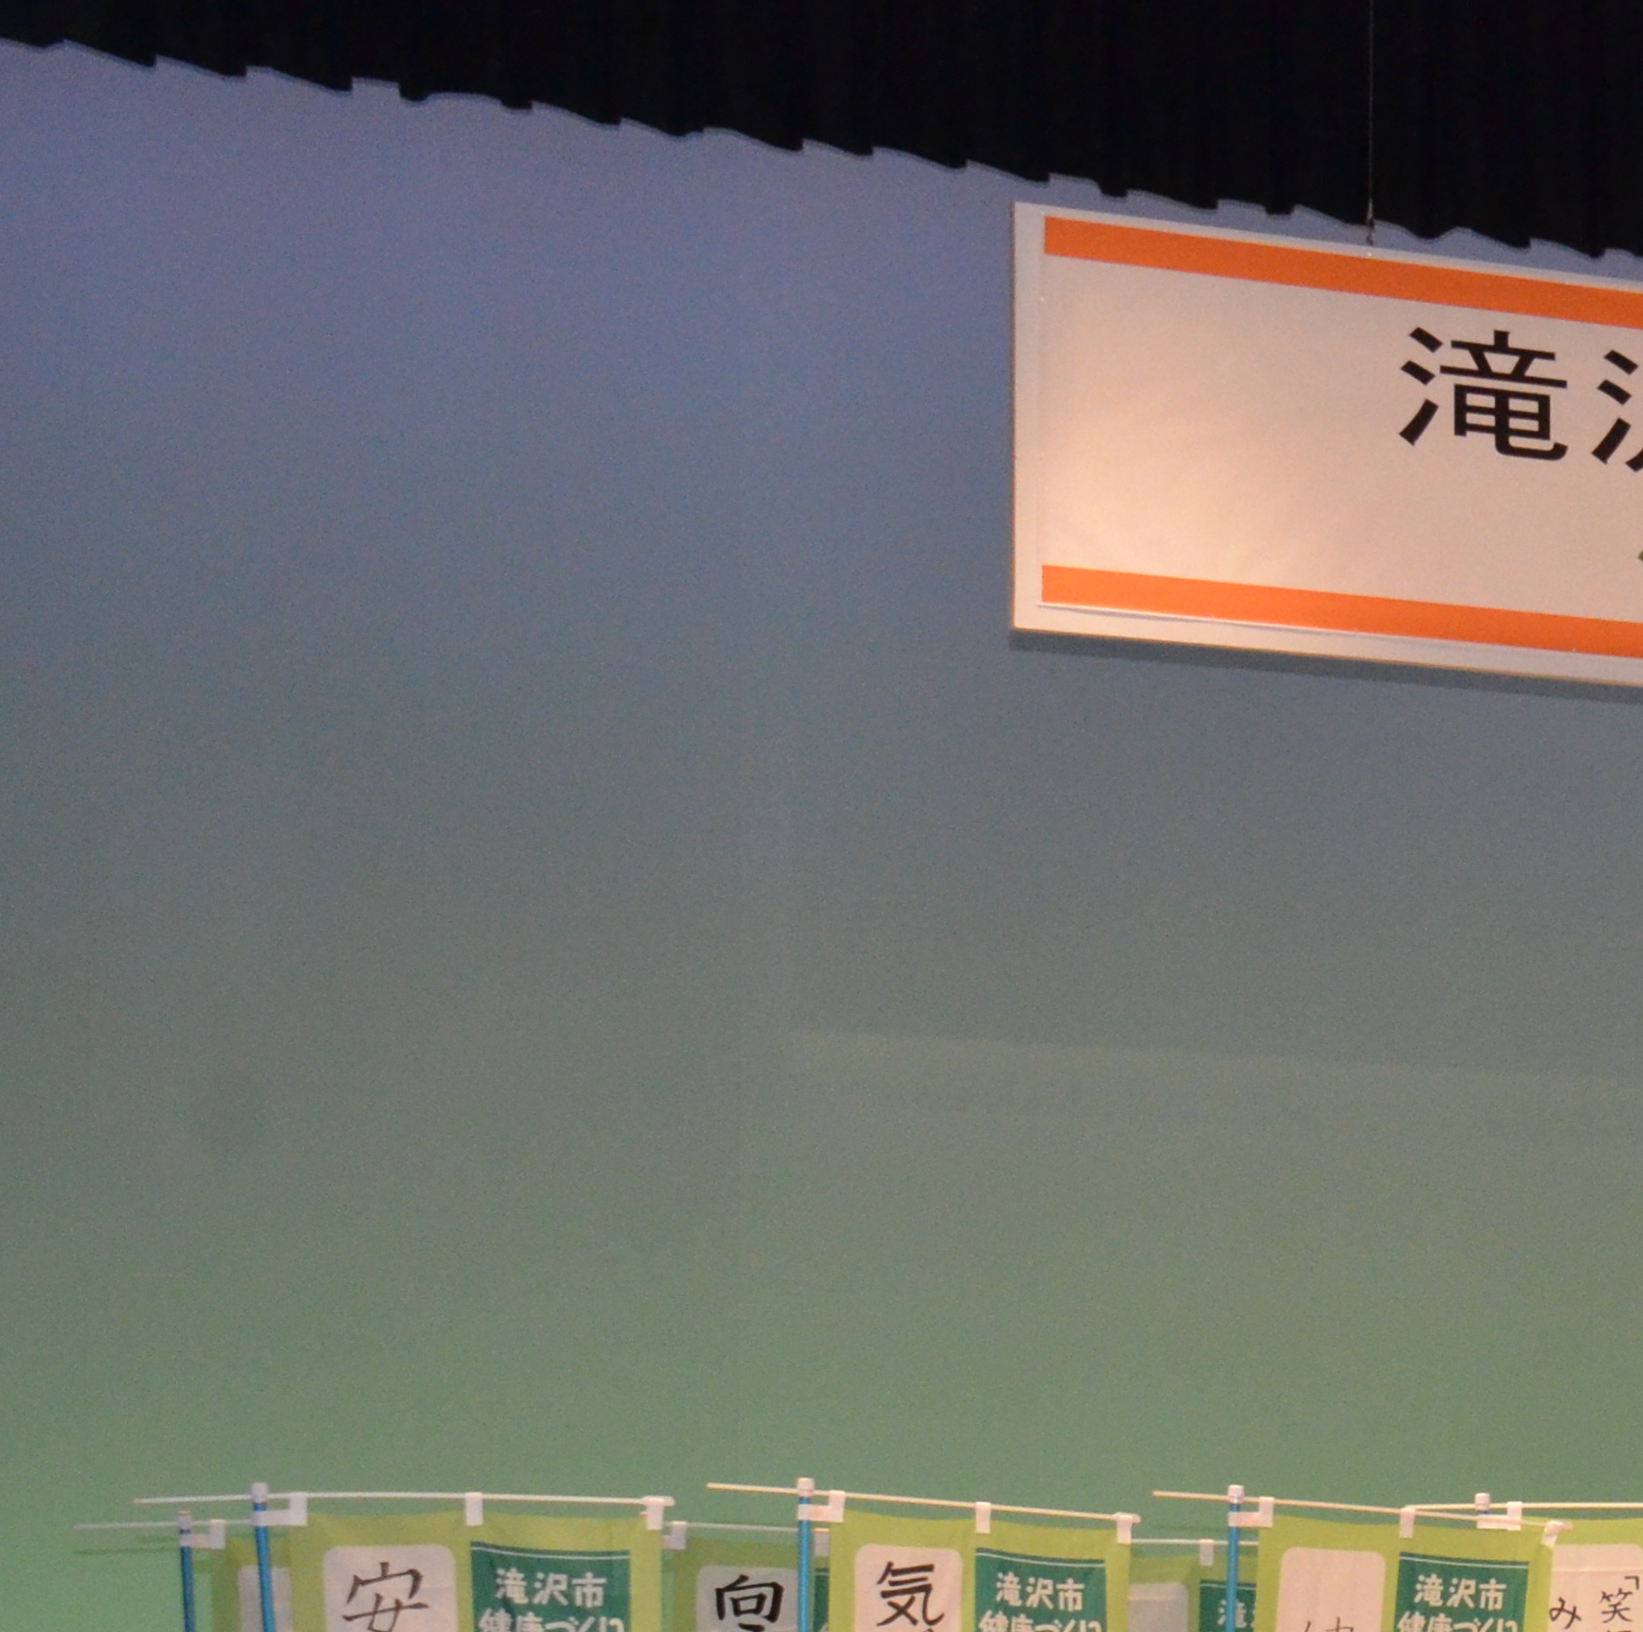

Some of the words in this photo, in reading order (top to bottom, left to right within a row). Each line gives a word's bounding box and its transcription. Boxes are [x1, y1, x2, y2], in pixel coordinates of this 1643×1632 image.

[495, 1567, 608, 1606] 滝沢市
[996, 1572, 1085, 1612] 滝沢市
[1414, 1575, 1508, 1610] 滝沢市
